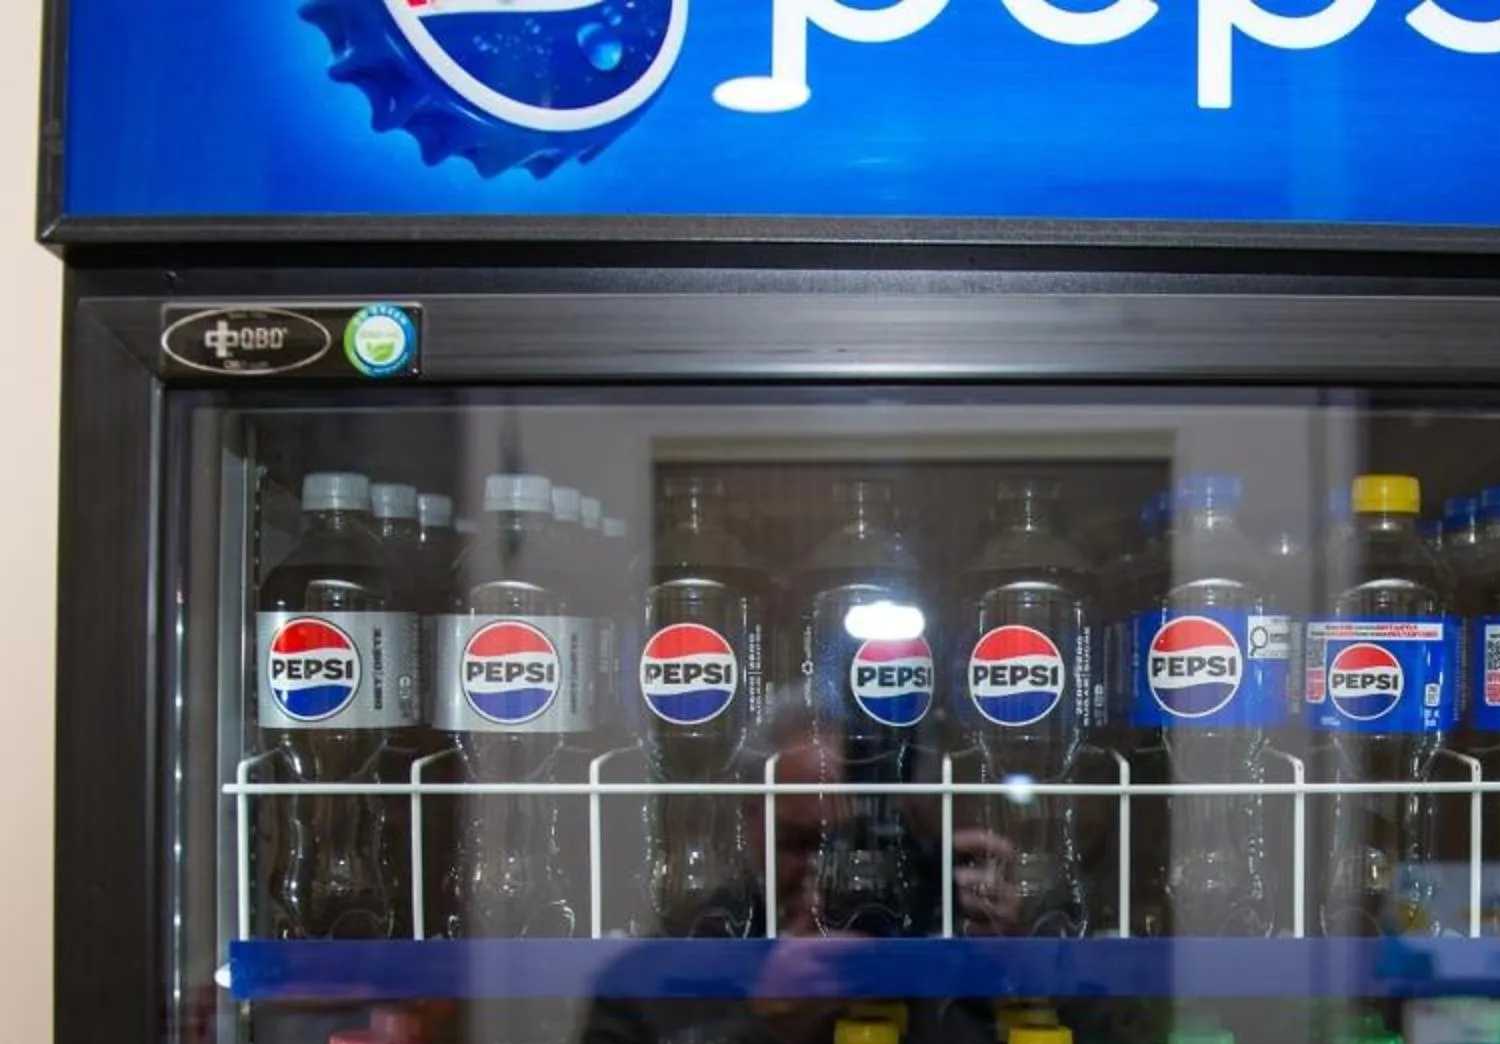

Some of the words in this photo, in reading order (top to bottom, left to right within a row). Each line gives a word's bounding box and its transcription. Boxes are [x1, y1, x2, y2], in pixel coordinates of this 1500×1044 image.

[272, 659, 353, 680] PEPSI
[466, 662, 554, 683] PEPSI
[644, 663, 732, 685] PEPSI
[857, 666, 932, 687] PEPSI
[973, 665, 1059, 687] PEPSI
[1152, 655, 1236, 677] PEPSI
[1332, 673, 1399, 691] PEPSI
